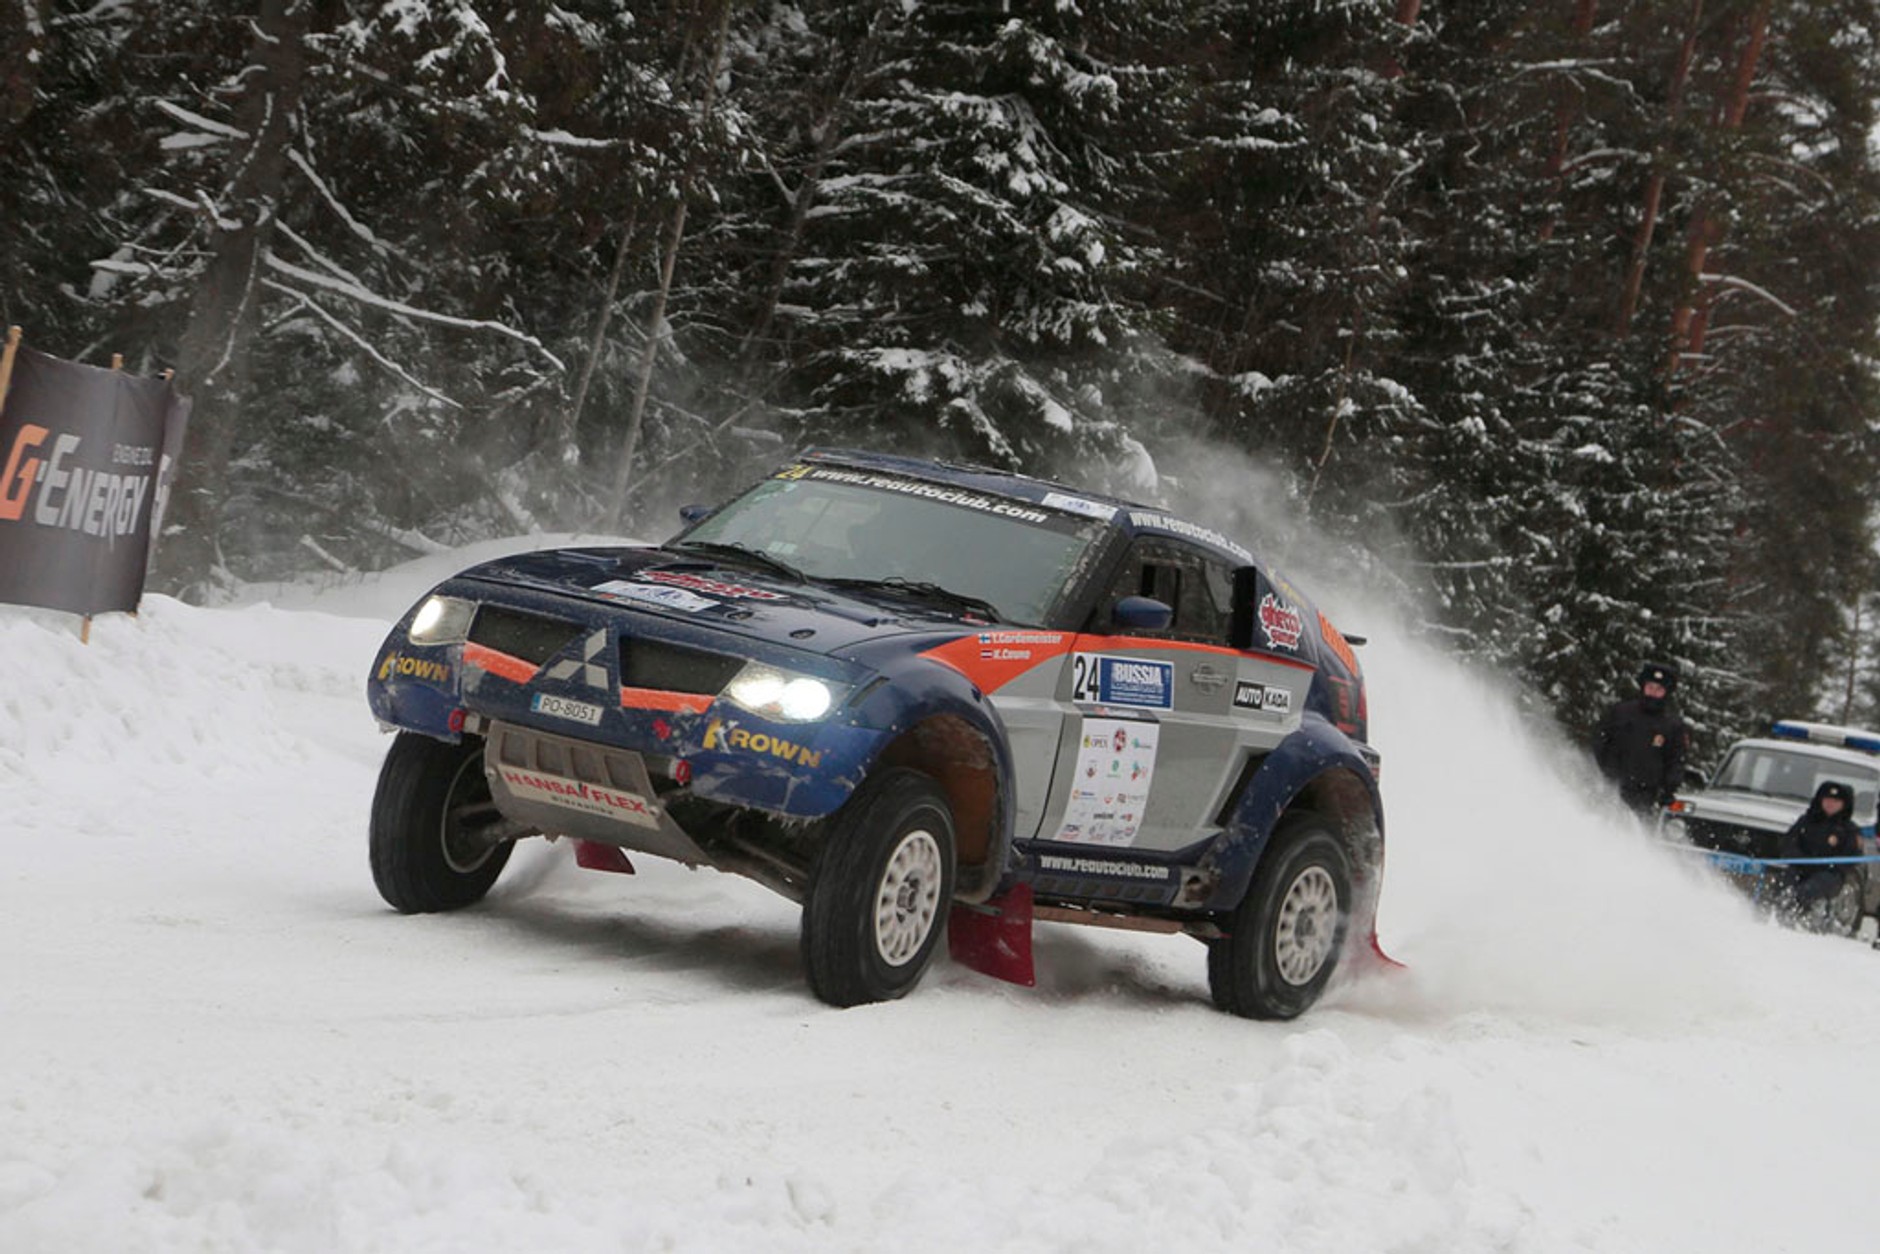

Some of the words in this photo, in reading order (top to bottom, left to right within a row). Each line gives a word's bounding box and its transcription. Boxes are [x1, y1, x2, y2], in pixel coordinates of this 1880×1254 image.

[776, 464, 814, 480] 24
[811, 469, 1048, 523] www.reautoclub.com
[1074, 655, 1099, 702] 24
[1236, 685, 1262, 705] AUTO
[702, 716, 822, 769] KROWN
[1040, 854, 1169, 879] www.reautoclub.com
